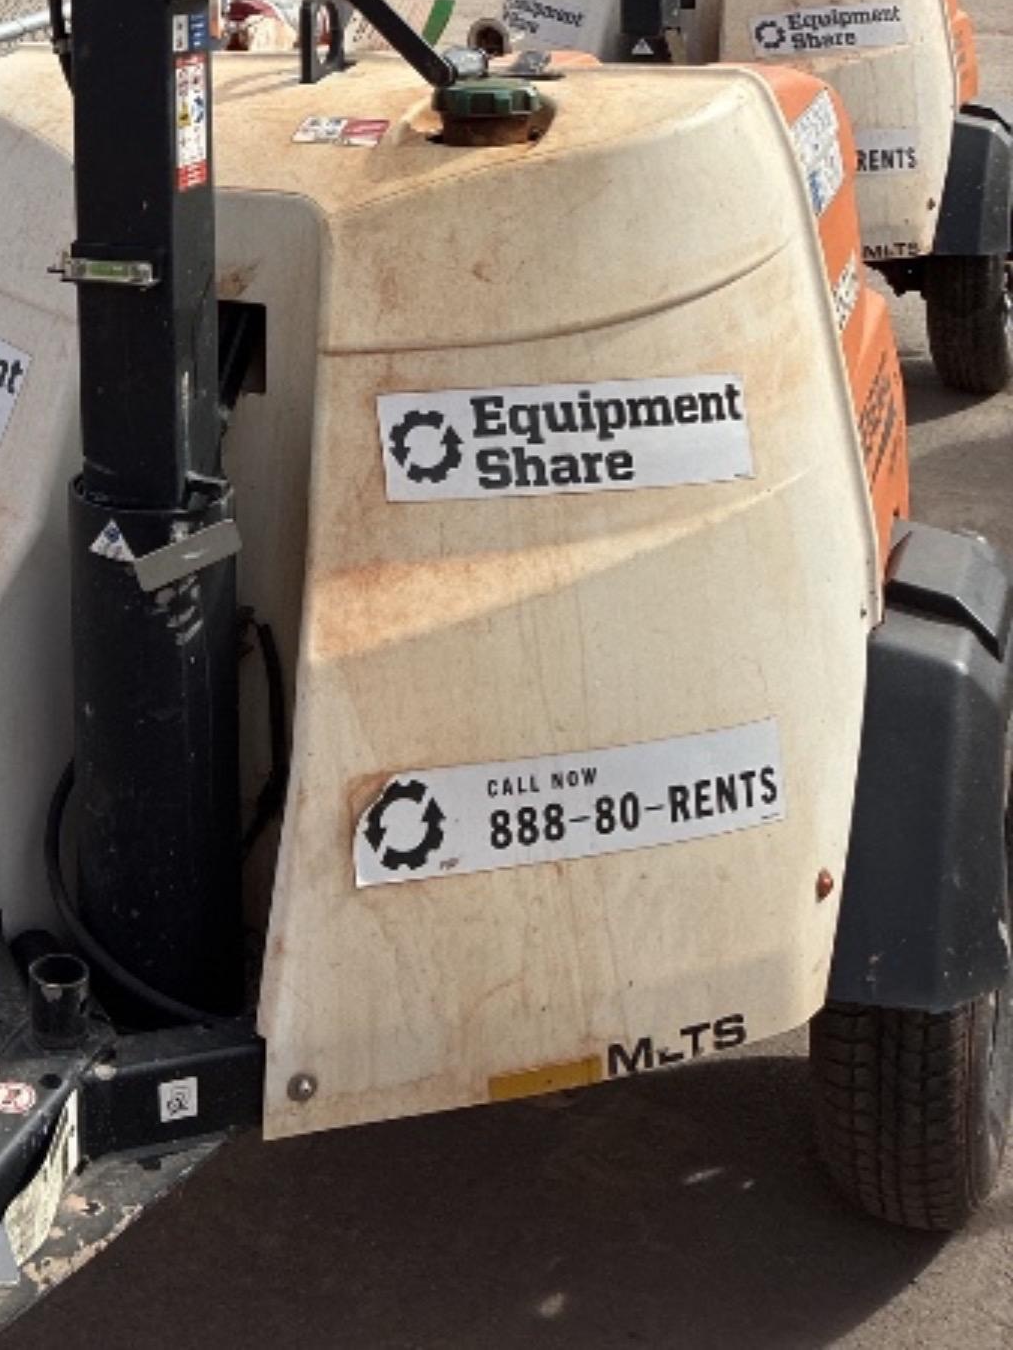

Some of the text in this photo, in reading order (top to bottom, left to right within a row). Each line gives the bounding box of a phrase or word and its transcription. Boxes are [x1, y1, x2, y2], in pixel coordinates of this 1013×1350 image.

[787, 5, 900, 32] Equipment
[791, 32, 856, 50] Share
[470, 383, 742, 444] Equipment
[476, 447, 634, 491] Share
[487, 767, 597, 798] CALL NOW
[489, 766, 777, 851] 888-80-RENTS
